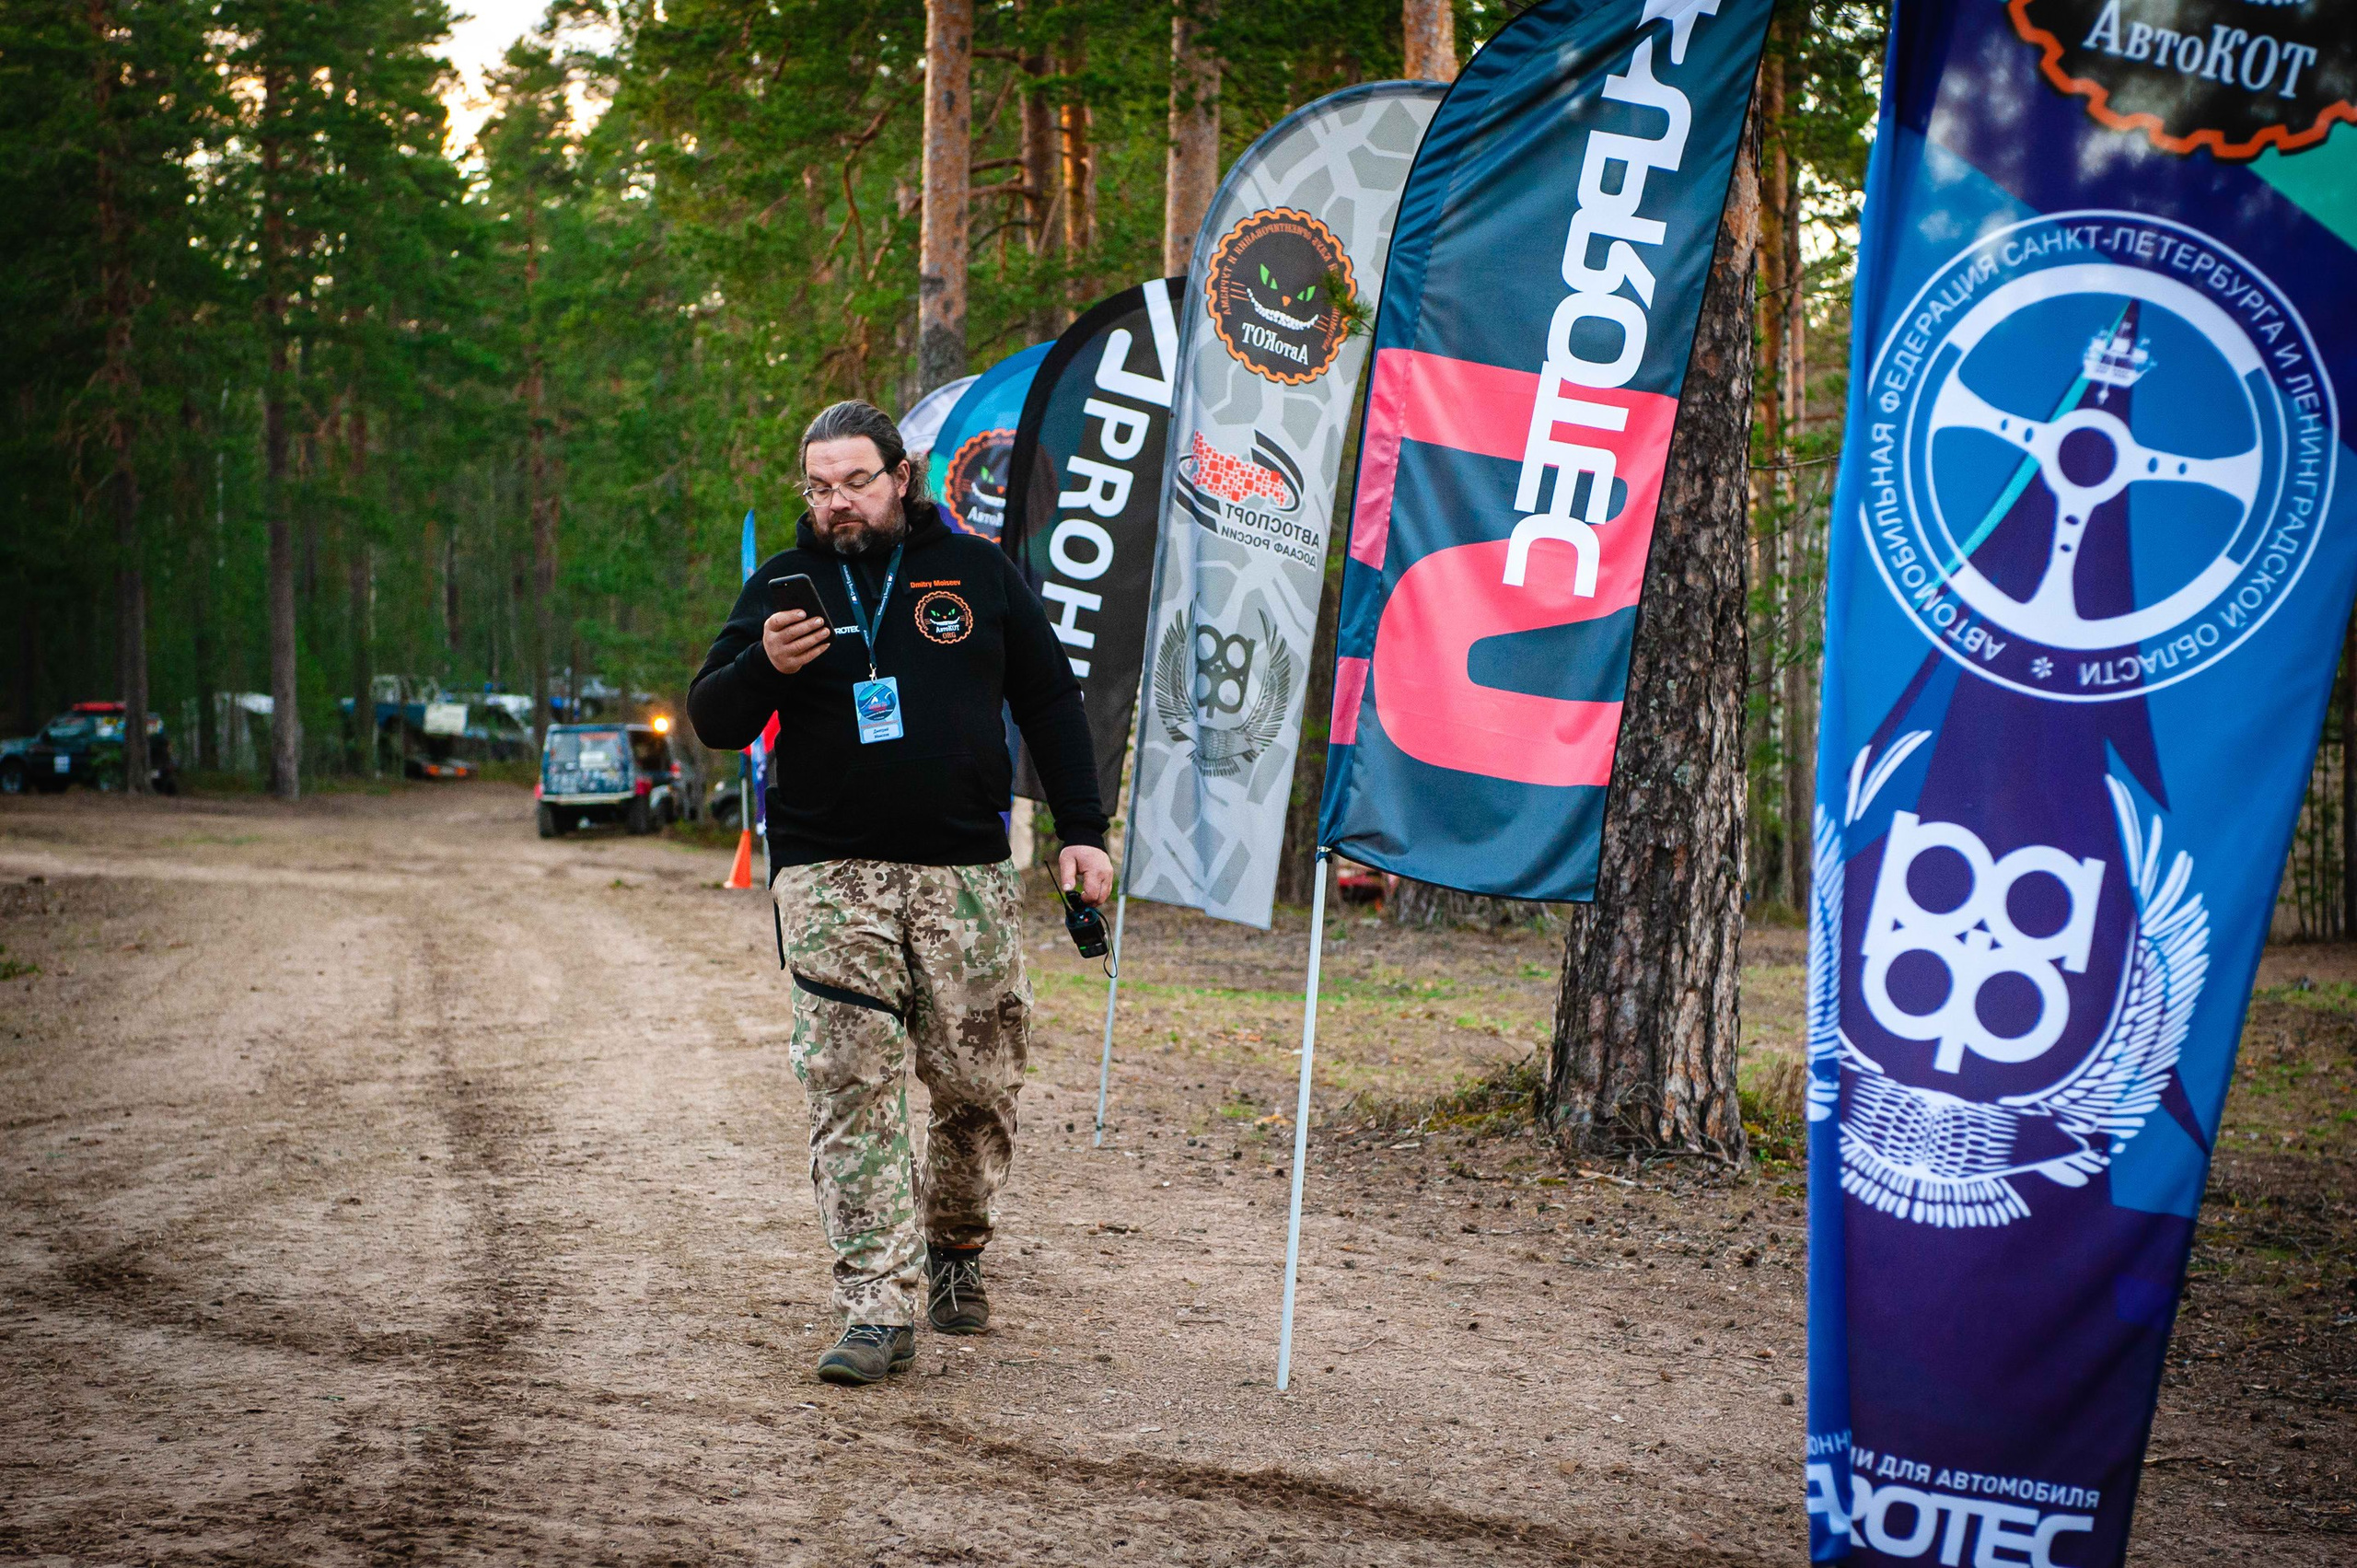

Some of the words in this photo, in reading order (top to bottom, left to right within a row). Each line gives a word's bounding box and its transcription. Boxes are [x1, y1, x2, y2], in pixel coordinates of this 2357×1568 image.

[2082, 0, 2318, 99] АвтоКОТ
[2003, 226, 2285, 338] САНКТ-ПЕТЕРБУРГА
[1880, 253, 1997, 413] ФЕДЕРАЦИЯ
[2274, 343, 2302, 367] И
[1870, 423, 2005, 661] АВТОМОБИЛЬНАЯ
[2221, 368, 2320, 629] ЛЕНИНГРАДСКОЙ
[934, 579, 961, 587] Moiseev
[2080, 624, 2221, 686] ОБЛАСТИ
[1876, 1455, 1932, 1484] ДЛЯ
[1934, 1468, 2101, 1510] АВТОМОБИЛЯ
